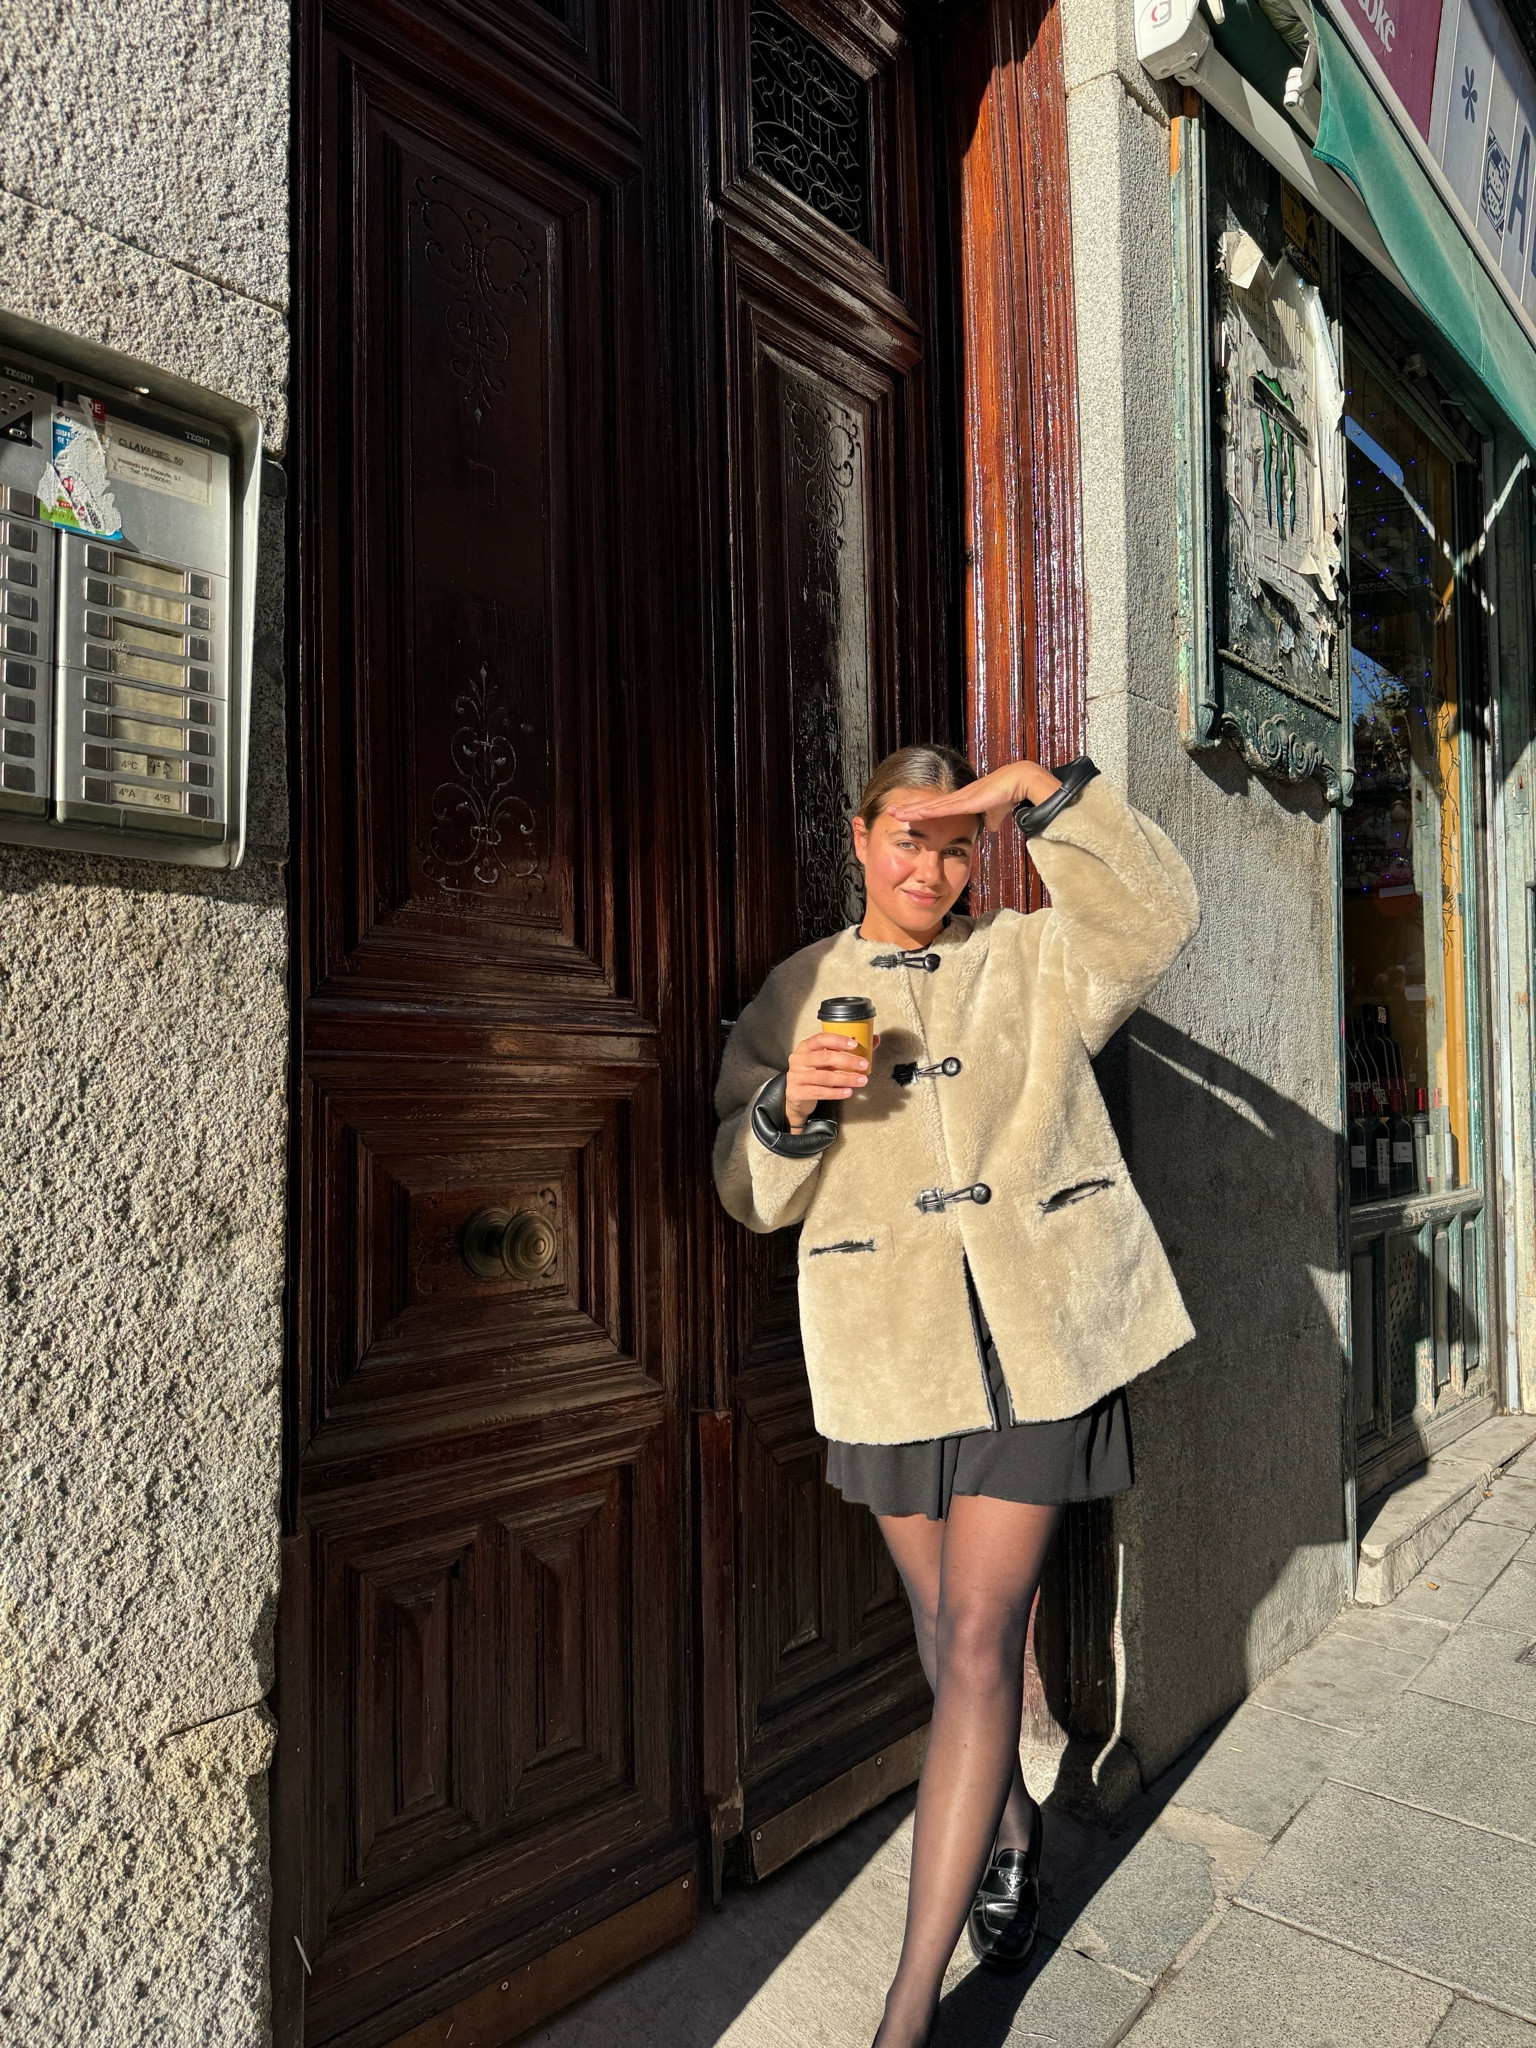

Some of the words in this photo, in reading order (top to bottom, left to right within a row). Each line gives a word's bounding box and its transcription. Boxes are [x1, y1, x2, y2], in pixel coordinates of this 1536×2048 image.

[1358, 0, 1396, 53] oke
[4, 366, 35, 384] TEGUI
[184, 431, 210, 446] TEGUI
[121, 760, 138, 770] 4ºC
[118, 787, 136, 798] 4ºA
[154, 793, 171, 804] 4ºB
